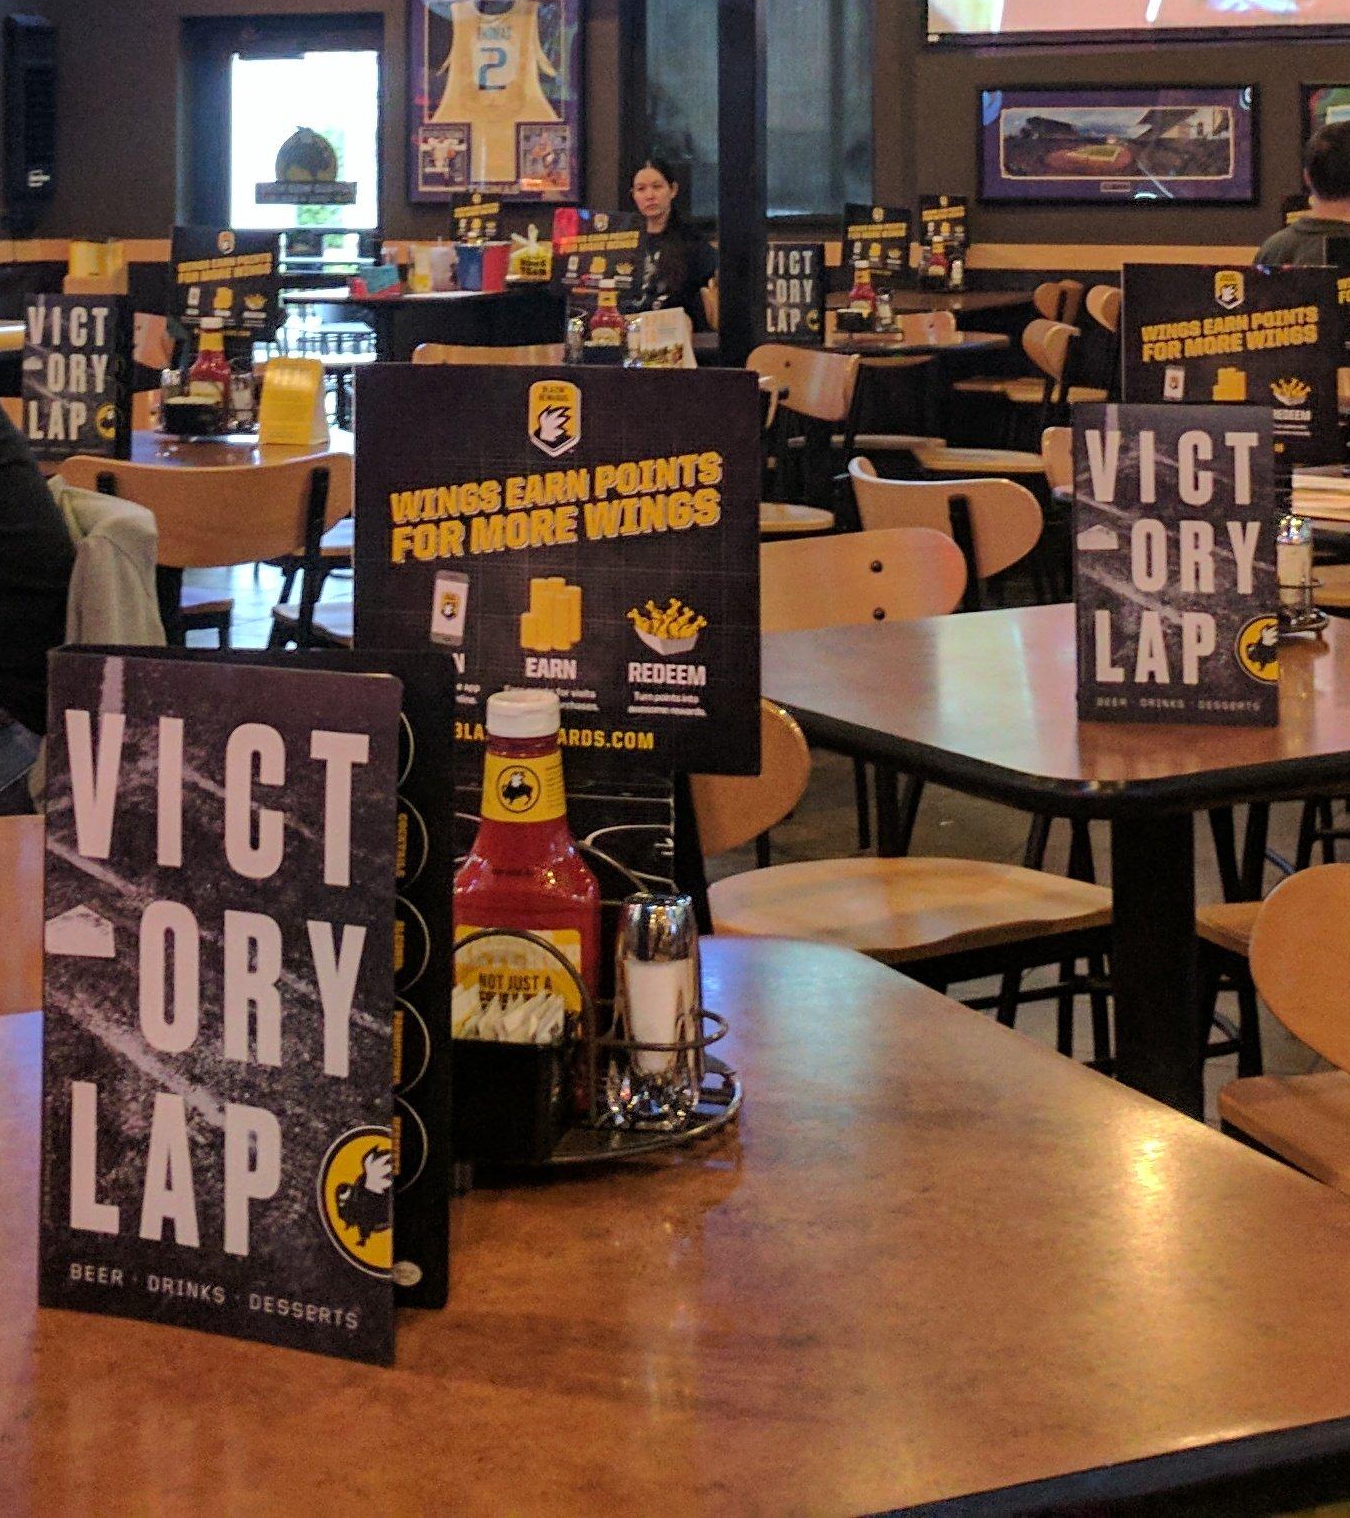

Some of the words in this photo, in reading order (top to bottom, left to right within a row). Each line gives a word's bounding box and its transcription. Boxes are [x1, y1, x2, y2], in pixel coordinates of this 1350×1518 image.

[477, 45, 509, 92] 2
[27, 306, 110, 347] VICT
[1141, 320, 1202, 344] WINGS
[1202, 312, 1247, 335] EARN
[1249, 305, 1320, 332] POINTS
[1141, 338, 1183, 364] FOR
[1183, 330, 1248, 358] MORE
[1248, 323, 1320, 352] WINGS
[47, 352, 110, 394] ORY
[28, 400, 87, 441] LAP
[390, 478, 503, 525] WINGS
[505, 464, 591, 507] EARN
[594, 450, 725, 497] POINTS
[1085, 430, 1258, 506] VICT
[390, 520, 467, 565] FOR
[470, 505, 580, 555] MORE
[583, 487, 723, 541] WINGS
[1131, 518, 1262, 595] ORY
[525, 656, 578, 680] EARN
[628, 661, 707, 686] REDEEM
[1095, 609, 1217, 685] LAP
[66, 709, 370, 887] VICT
[139, 900, 367, 1079] ORY
[508, 973, 541, 991] JUST
[69, 1081, 284, 1257] LAP
[69, 1262, 125, 1286] BEER
[147, 1273, 226, 1305] DRINKS
[248, 1291, 359, 1330] DESSERTS
